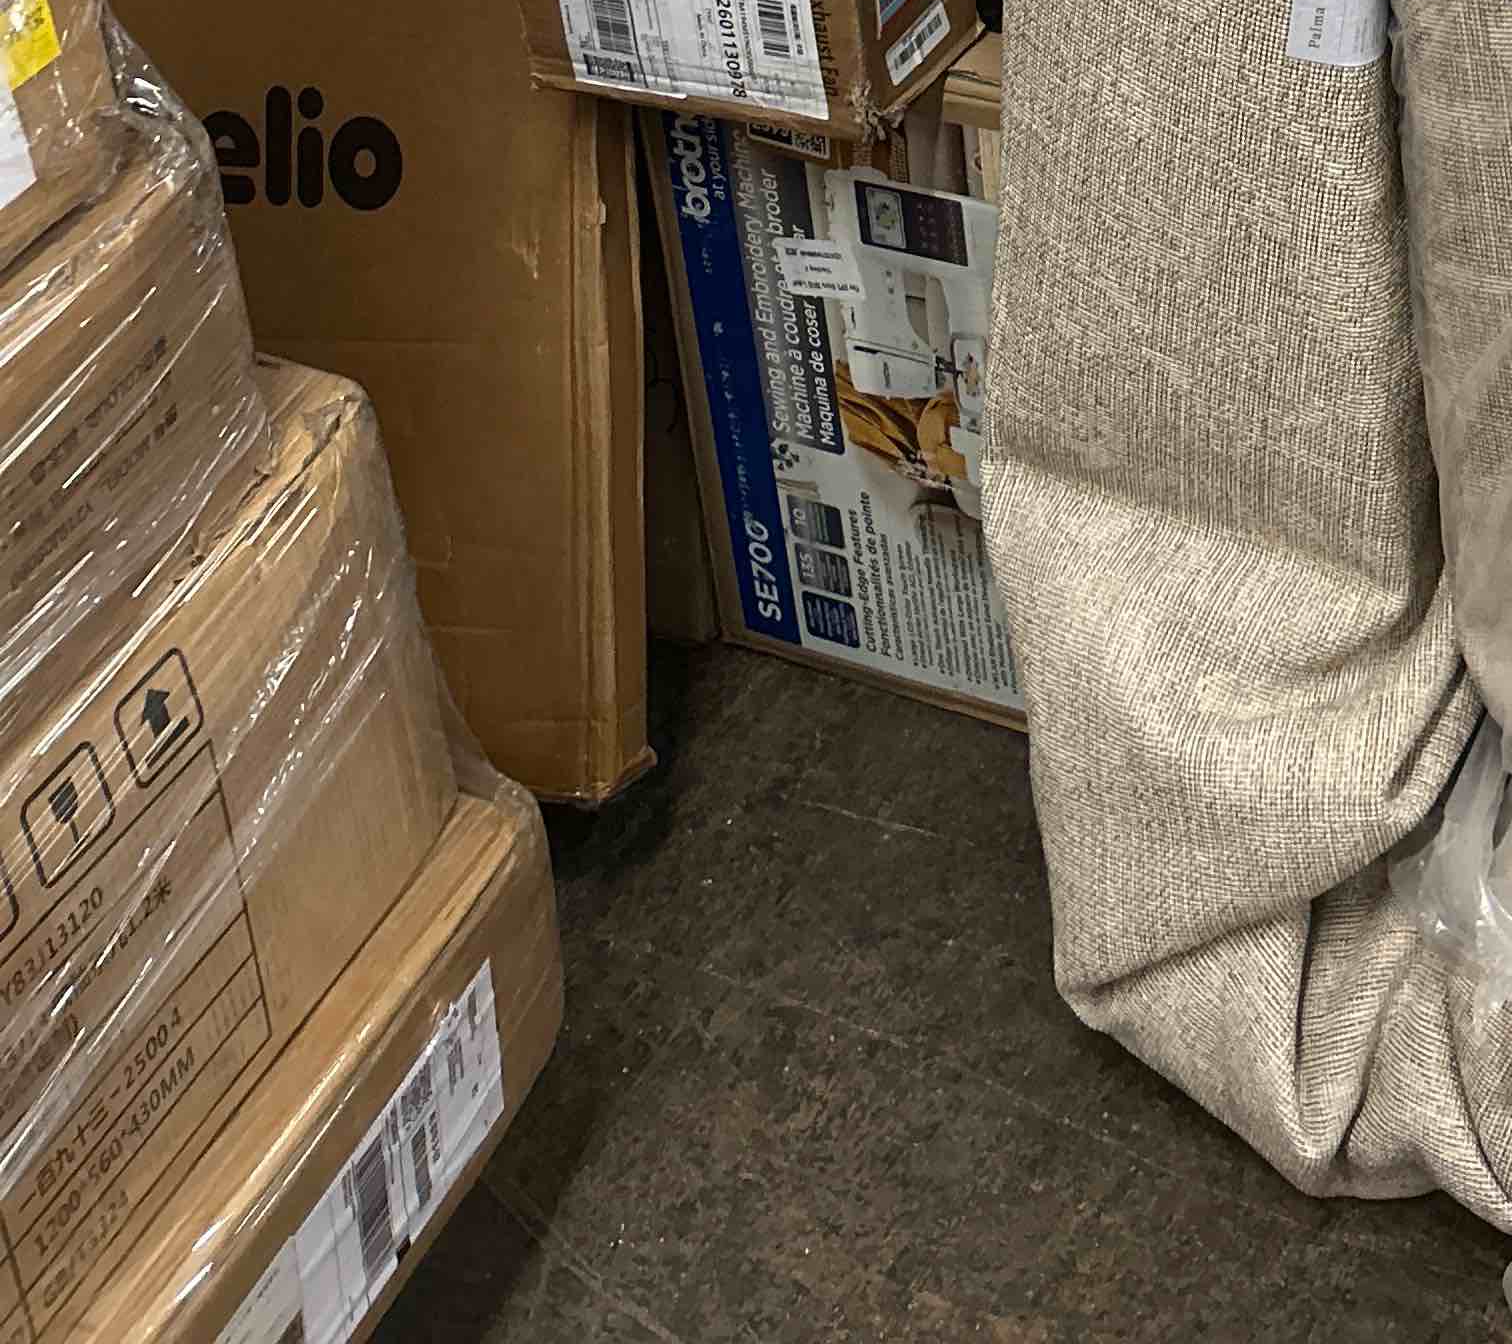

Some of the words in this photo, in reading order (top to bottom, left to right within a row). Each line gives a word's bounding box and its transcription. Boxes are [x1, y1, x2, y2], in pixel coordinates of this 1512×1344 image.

[1307, 6, 1326, 50] Palma
[199, 84, 403, 212] elio
[670, 114, 711, 220] broth
[758, 167, 784, 235] broder
[743, 214, 775, 323] Embroidery
[759, 327, 780, 364] and
[802, 301, 822, 348] coser
[809, 351, 825, 373] de
[765, 366, 792, 434] Sewing
[789, 363, 814, 440] Machine
[848, 508, 864, 564] Features
[860, 491, 875, 536] pointe
[745, 519, 783, 623] SE700
